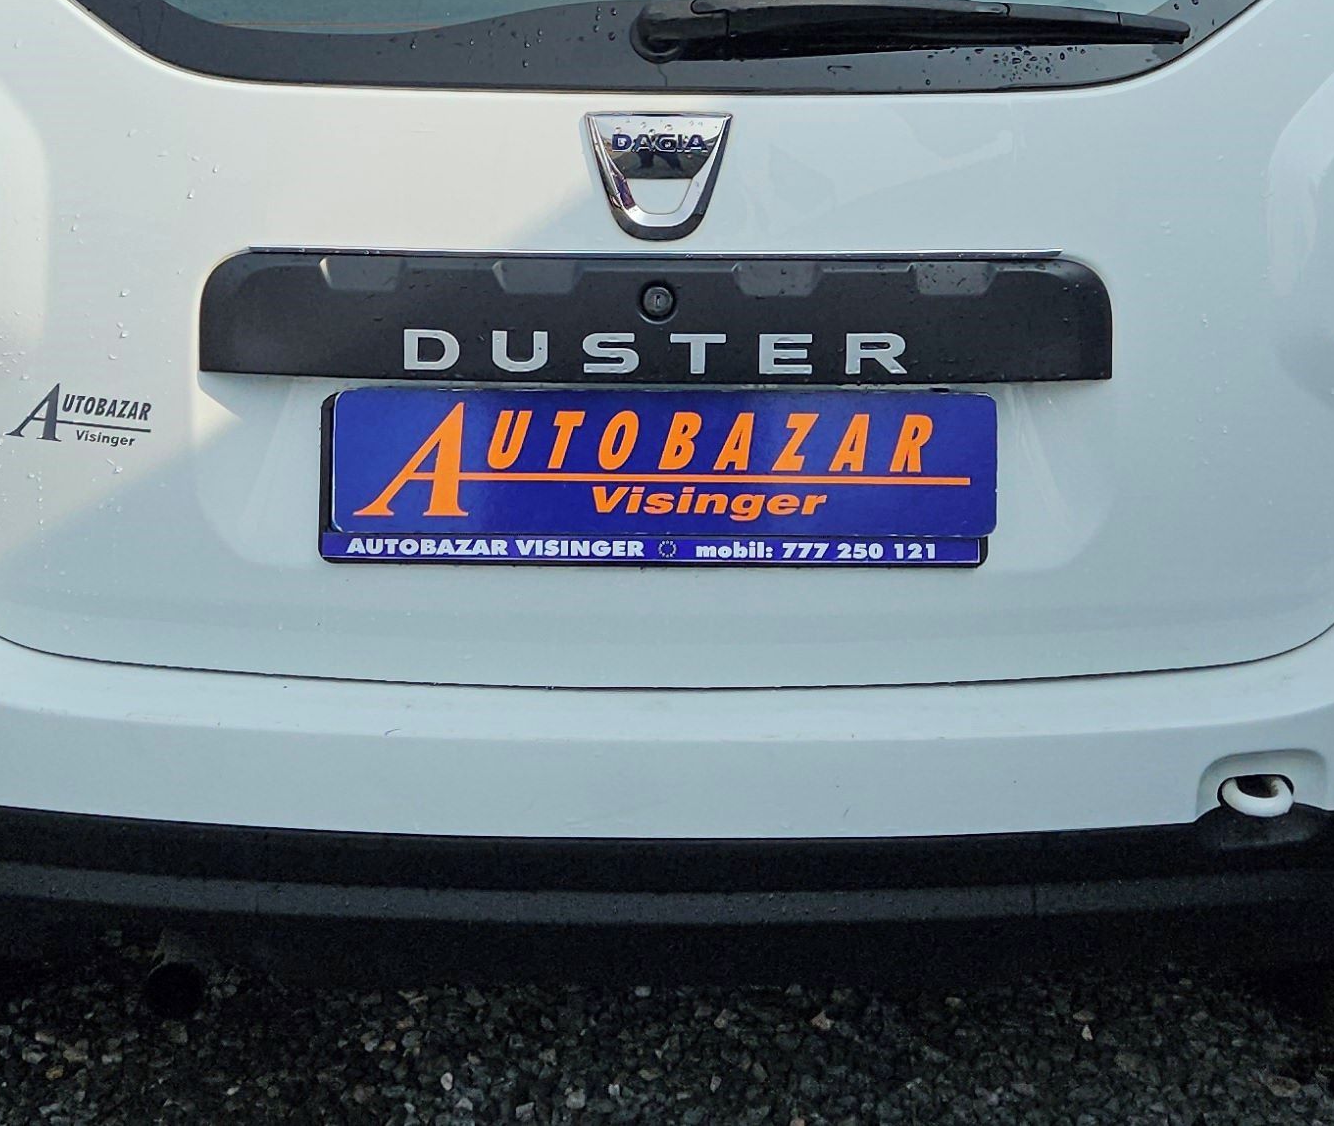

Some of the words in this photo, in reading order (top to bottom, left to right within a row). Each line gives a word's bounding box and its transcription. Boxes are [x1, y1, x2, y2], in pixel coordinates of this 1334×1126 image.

[611, 134, 709, 153] DACIA
[402, 328, 908, 375] DUSTER
[5, 383, 152, 442] AUTOBAZAR
[75, 430, 136, 447] Visinger
[353, 401, 934, 518] AUTOBAZAR
[590, 485, 828, 522] Visinger
[346, 537, 508, 556] AUTOBAZAR
[515, 538, 645, 557] VISINGER
[694, 541, 774, 560] mobil:
[781, 543, 830, 560] 777
[836, 544, 884, 561] 250
[891, 544, 938, 561] 121
